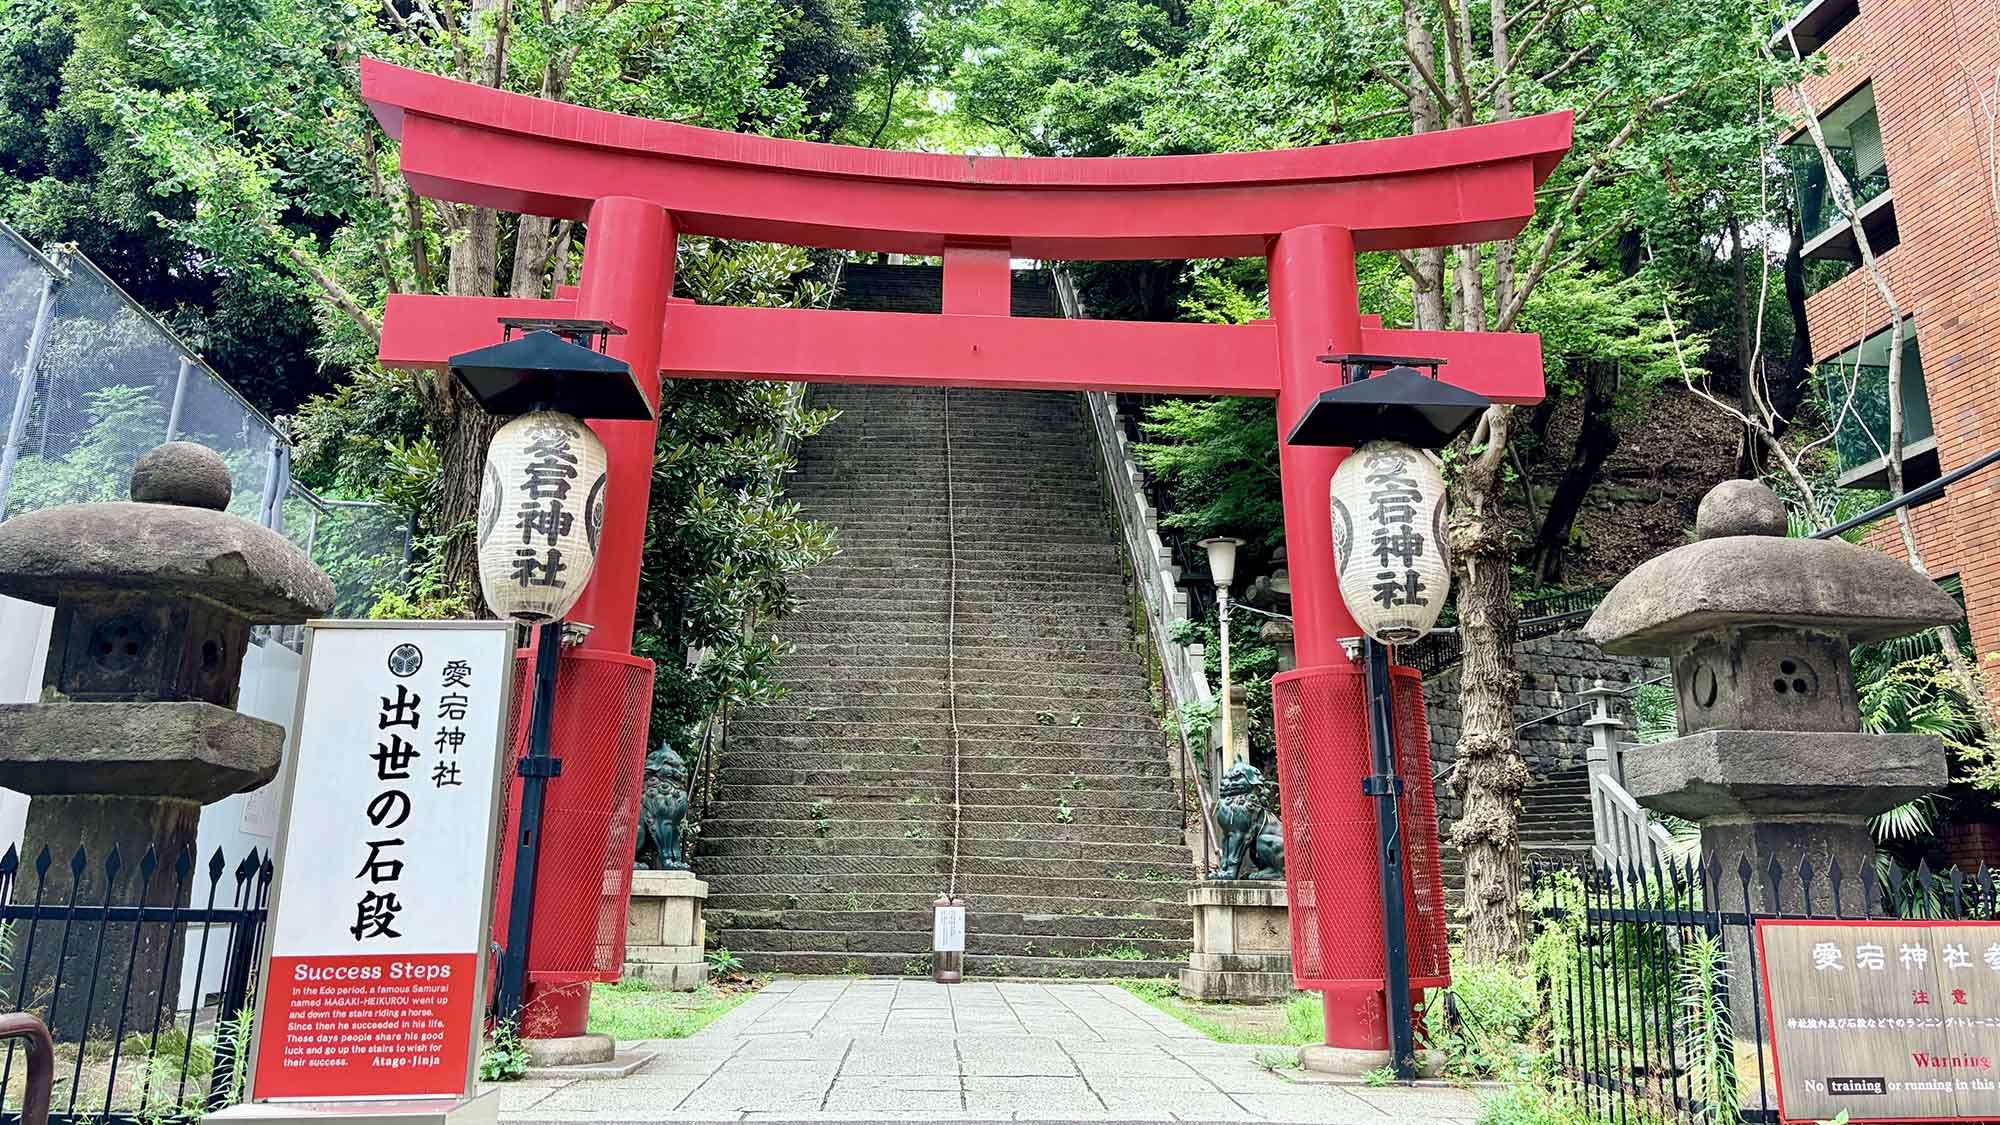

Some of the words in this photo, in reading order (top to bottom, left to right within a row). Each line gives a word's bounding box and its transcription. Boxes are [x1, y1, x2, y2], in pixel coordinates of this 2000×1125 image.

[510, 422, 581, 589] 愛宕神社
[1363, 450, 1429, 609] 愛宕神社
[431, 659, 473, 789] 愛宕神社
[350, 684, 422, 942] 出世の石段
[294, 963, 382, 980] Success
[389, 962, 451, 980] Steps
[292, 987, 301, 995] In
[303, 986, 318, 995] the
[319, 986, 336, 995] Edo
[377, 985, 410, 994] famous
[412, 983, 449, 993] Samurai
[290, 998, 321, 1007] named
[323, 997, 409, 1006] MAGAKI-HEIKUROU
[412, 996, 434, 1004] went
[436, 996, 449, 1005] up
[1912, 989, 1968, 1006] 注意
[289, 1010, 306, 1018] and
[307, 1010, 330, 1018] down
[332, 1009, 347, 1017] the
[348, 1009, 373, 1017] stairs
[374, 1009, 400, 1017] riding
[408, 1008, 433, 1016] horse.
[287, 1022, 313, 1030] Since
[315, 1022, 336, 1030] then
[351, 1020, 399, 1029] succeeded
[401, 1020, 410, 1028] in
[412, 1020, 426, 1028] his
[287, 1034, 314, 1042] These
[316, 1034, 338, 1043] days
[340, 1033, 372, 1042] people
[375, 1032, 402, 1041] share
[404, 1032, 418, 1040] his
[420, 1031, 444, 1041] good
[284, 1046, 304, 1055] luck
[305, 1046, 323, 1055] and
[324, 1047, 336, 1055] go
[337, 1046, 350, 1055] up
[351, 1045, 366, 1053] the
[367, 1044, 394, 1053] stairs
[429, 1043, 442, 1052] for
[283, 1058, 306, 1067] their
[308, 1058, 349, 1067] success.
[1912, 1052, 1992, 1070] Warning
[1804, 1080, 1824, 1092] No
[1832, 1080, 1882, 1094] training
[1887, 1082, 1903, 1091] or
[1904, 1080, 1953, 1093] running
[1956, 1080, 1969, 1090] in
[1971, 1078, 1995, 1090] this
